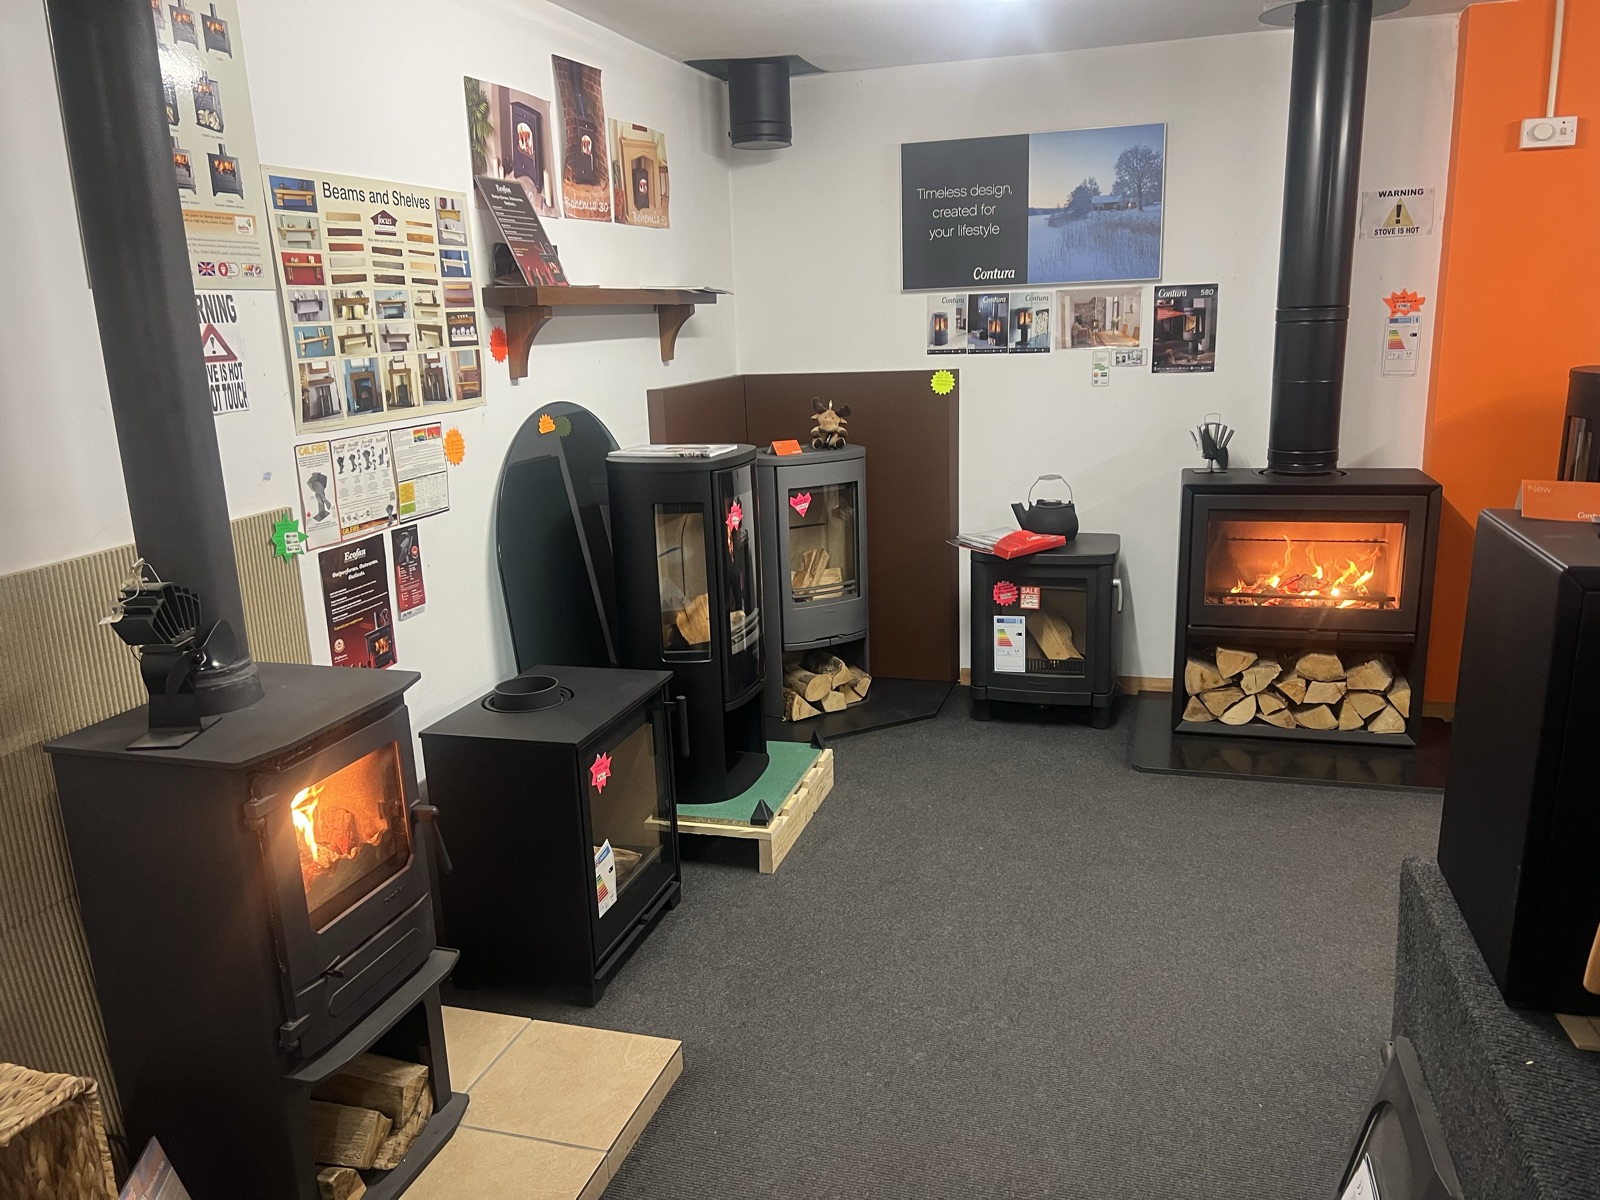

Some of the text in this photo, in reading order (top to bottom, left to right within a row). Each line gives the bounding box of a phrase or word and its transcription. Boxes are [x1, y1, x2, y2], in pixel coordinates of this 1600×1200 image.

[322, 182, 430, 209] Beams and Shelves
[917, 184, 1012, 200] Timeless design,
[1378, 188, 1424, 198] WARNING
[599, 202, 608, 212] 30
[932, 203, 996, 218] created for
[929, 222, 1000, 240] your lifestyle
[1374, 228, 1396, 236] STOVE
[1406, 226, 1420, 234] HOT
[973, 267, 1015, 280] Contura
[1025, 294, 1049, 302] Contura
[1158, 288, 1214, 297] Contura 580
[941, 296, 965, 304] Contura
[982, 295, 1007, 304] Contura
[195, 294, 237, 324] RNING
[220, 363, 228, 381] IS
[228, 362, 243, 381] HOT
[210, 384, 222, 412] OT
[298, 443, 328, 456] CALFIRE
[1528, 484, 1551, 493] New
[344, 547, 366, 562] Ecofan
